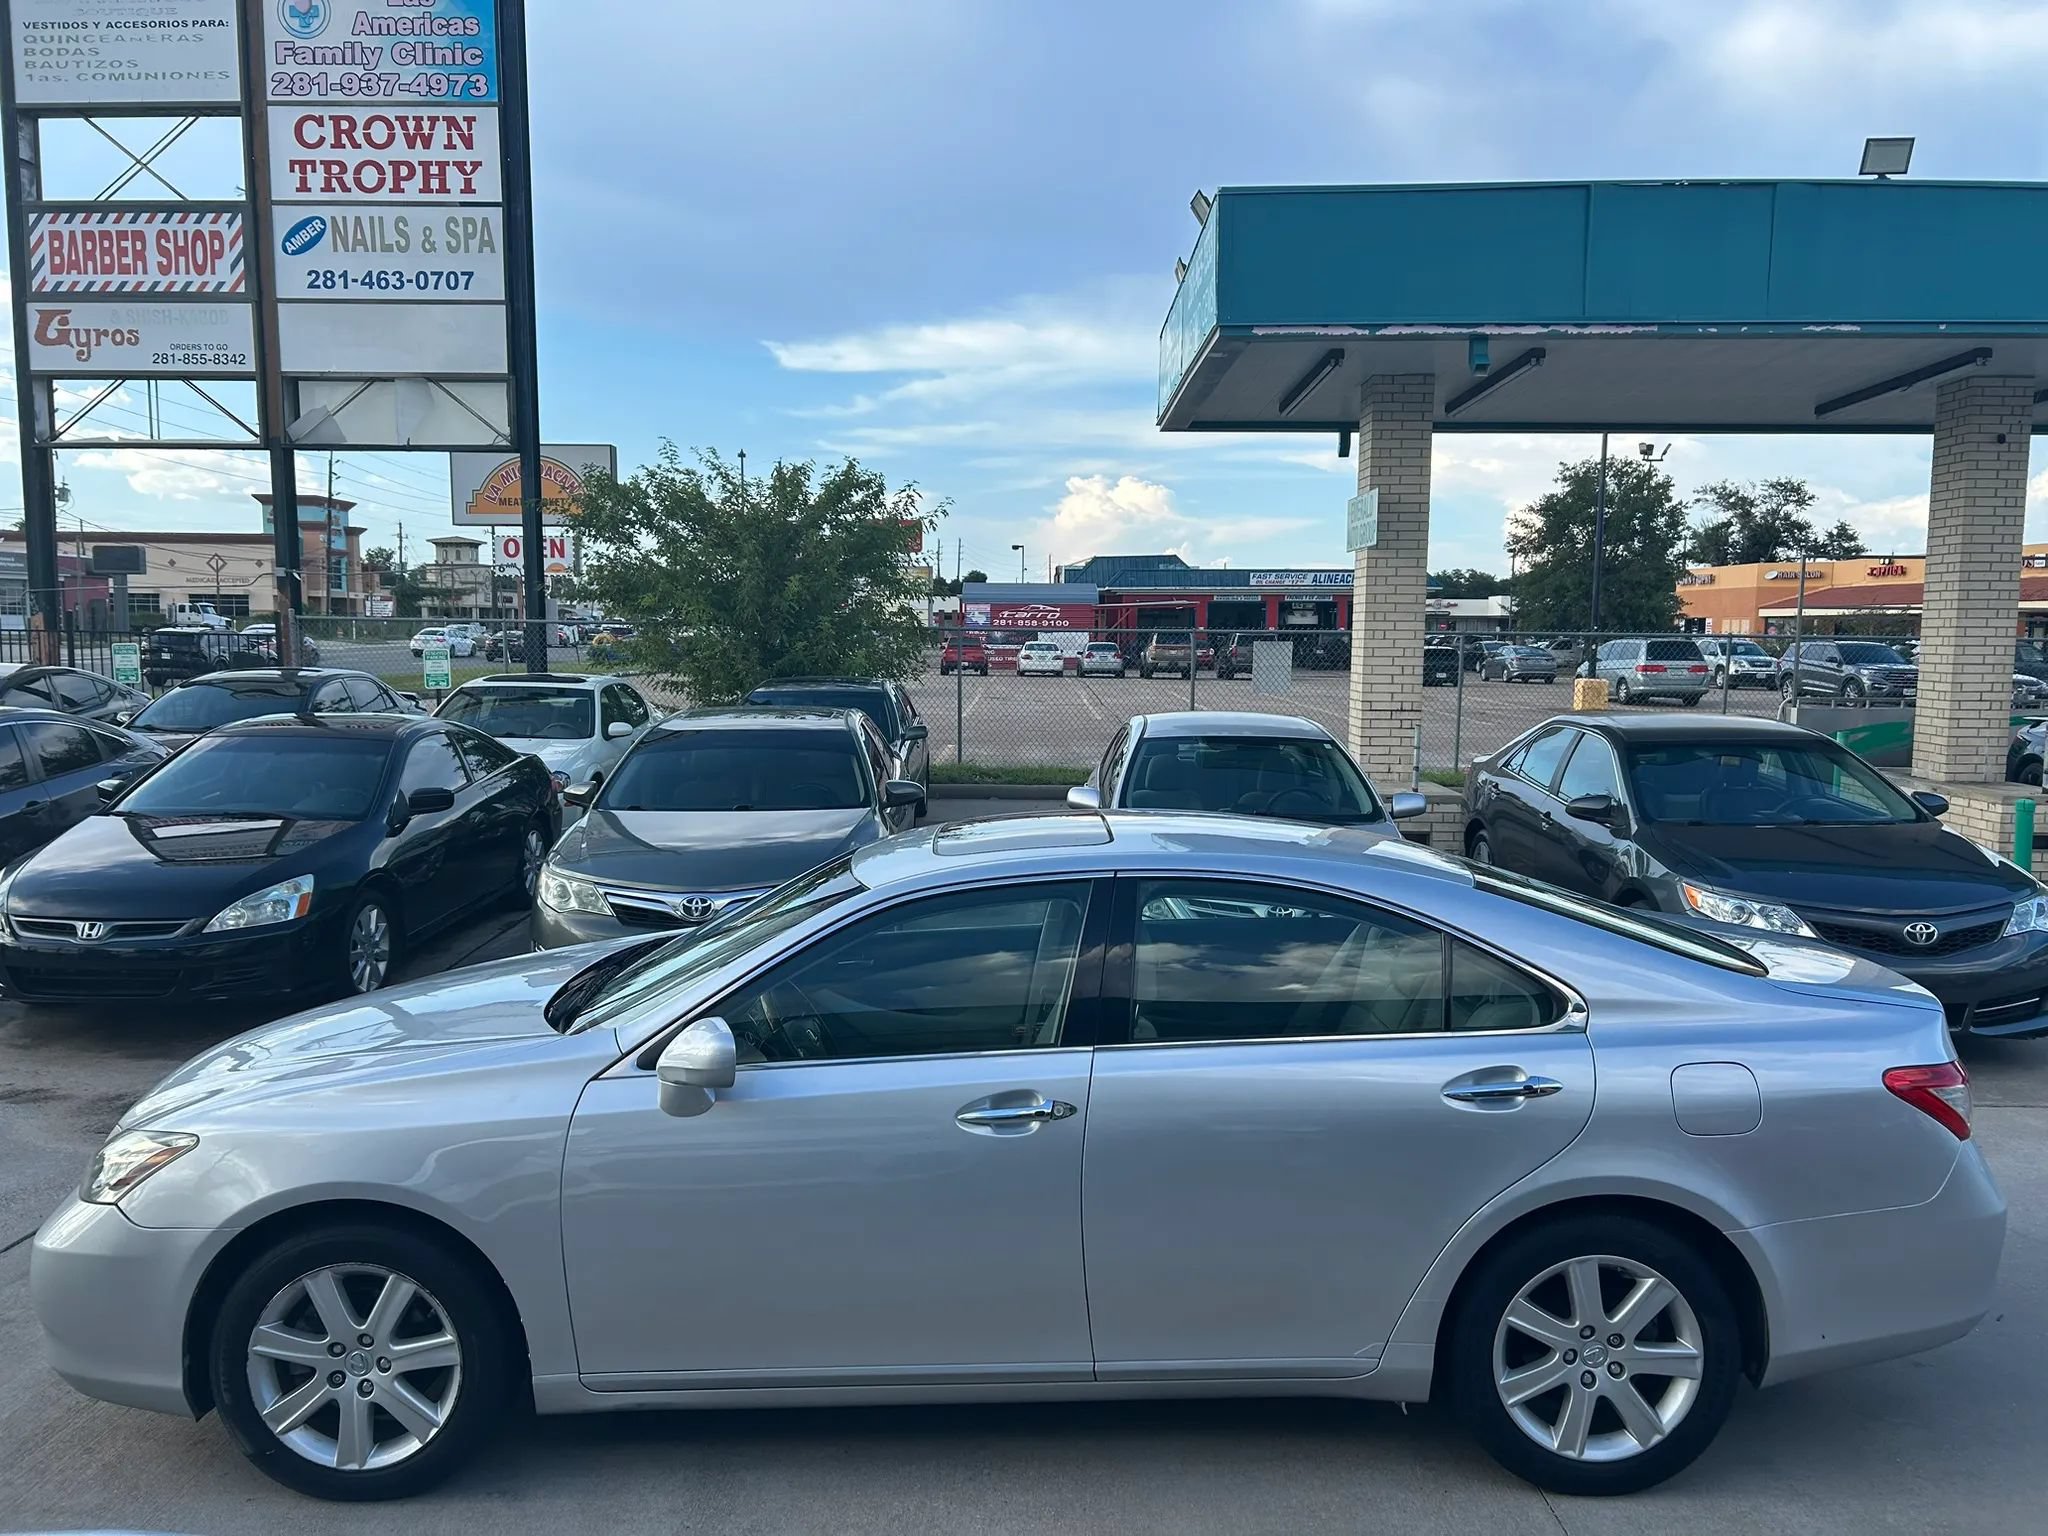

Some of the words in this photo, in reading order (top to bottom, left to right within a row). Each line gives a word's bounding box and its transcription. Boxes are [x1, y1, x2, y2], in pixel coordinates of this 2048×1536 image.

[23, 21, 88, 30] VESTIDOS
[92, 21, 101, 30] Y
[105, 20, 189, 29] ACCESORIOS
[191, 19, 230, 28] PARA:
[352, 11, 480, 36] Americas
[23, 47, 100, 57] BODAS
[275, 41, 383, 71] Family
[391, 41, 484, 66] Clinic
[24, 59, 139, 70] BAUTIZOS
[76, 71, 231, 82] COMUNIONES
[271, 72, 488, 97] 281-937-4973
[294, 114, 477, 150] CROWN
[289, 159, 482, 194] TROPHY
[284, 218, 325, 254] AMBER
[330, 215, 411, 253] NAILS
[421, 226, 437, 254] &
[445, 216, 496, 254] SPA
[48, 229, 148, 275] BARBER
[155, 229, 225, 276] SHOP
[306, 269, 475, 291] 281-463-0707
[34, 309, 140, 363] Gyros
[170, 343, 201, 351] ORDERS
[204, 343, 214, 351] TO
[216, 343, 228, 351] GO
[152, 353, 246, 365] 281-855-8342
[484, 482, 504, 504] LA
[499, 497, 522, 507] MEA
[503, 537, 565, 559] ON
[1796, 570, 1820, 579] SLON
